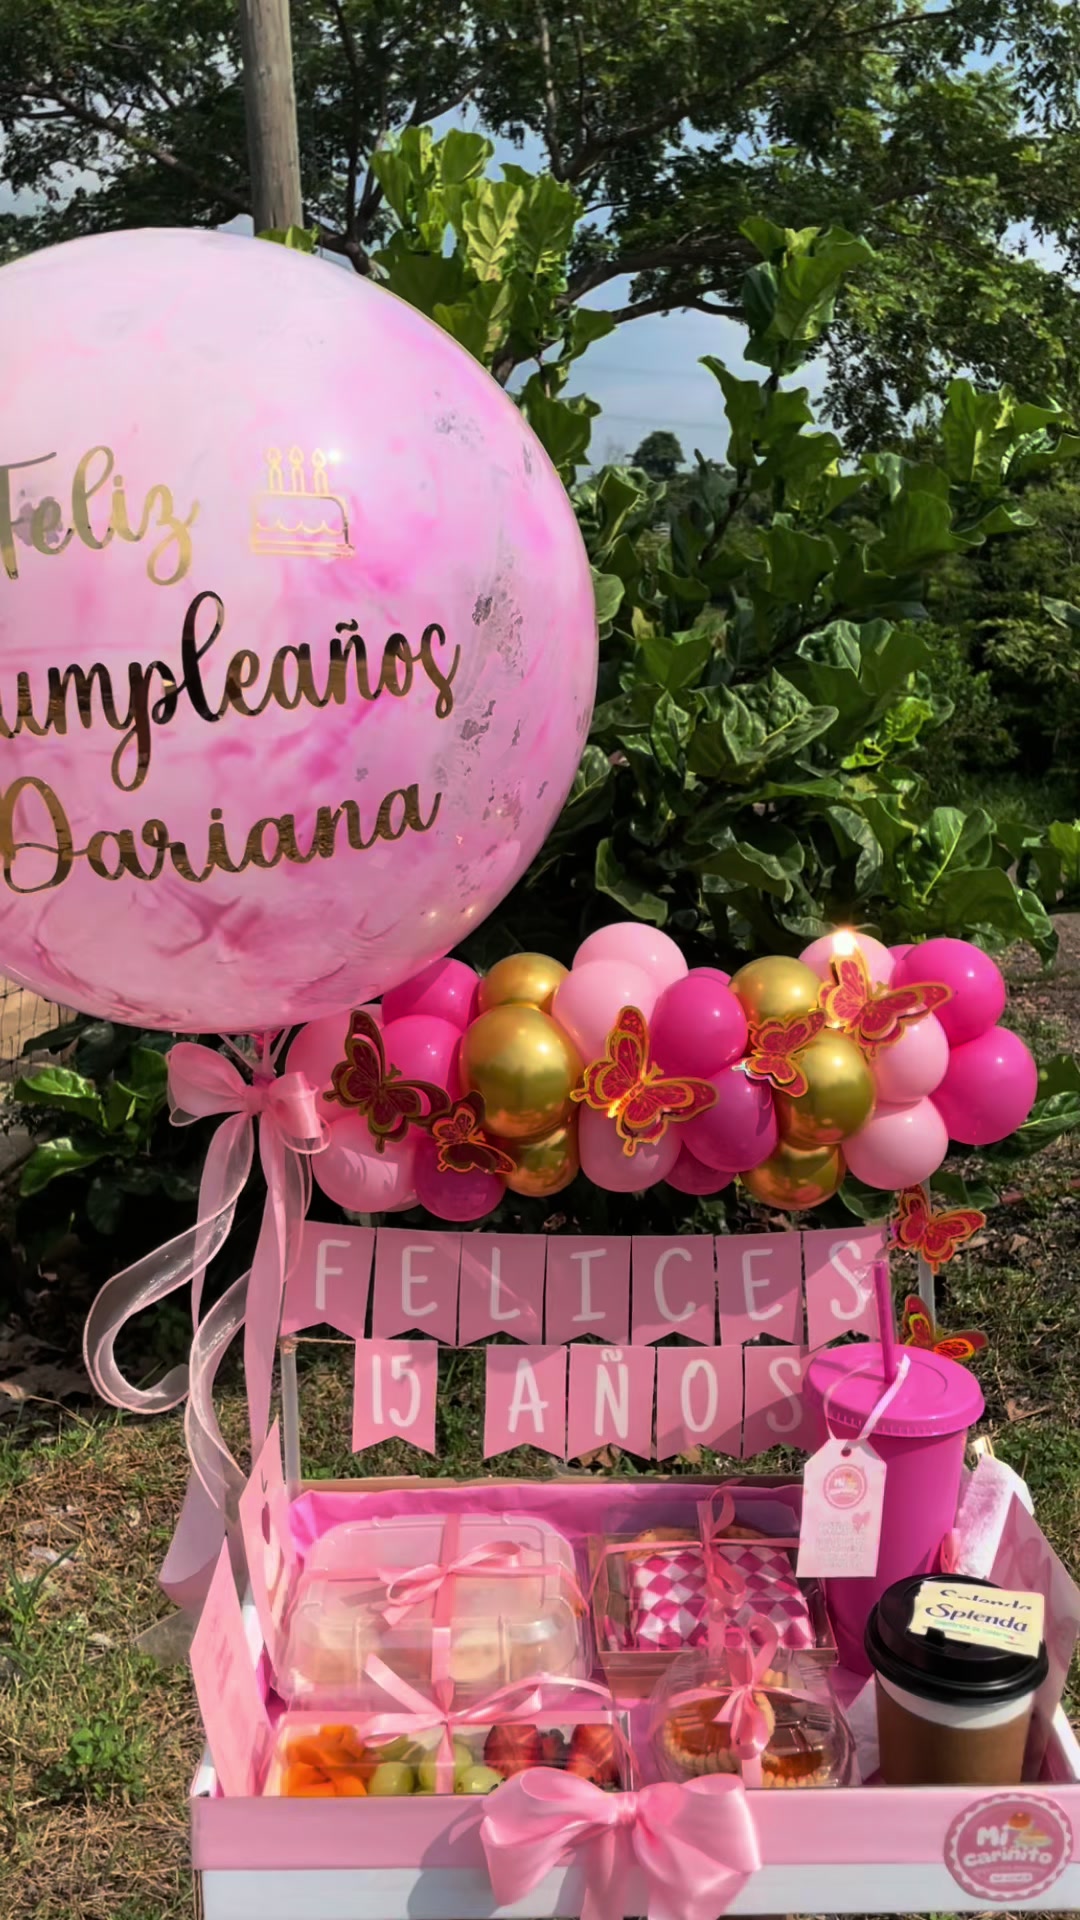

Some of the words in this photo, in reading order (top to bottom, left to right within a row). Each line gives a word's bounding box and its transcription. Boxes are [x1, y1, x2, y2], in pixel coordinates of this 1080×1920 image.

[0, 445, 200, 586] Feliz
[0, 776, 442, 894] Dariana
[315, 1239, 870, 1322] FELICES
[371, 1353, 422, 1428] 15
[507, 1348, 804, 1440] AÑOS
[924, 1602, 1029, 1632] Splenda
[976, 1824, 1009, 1847] Mi
